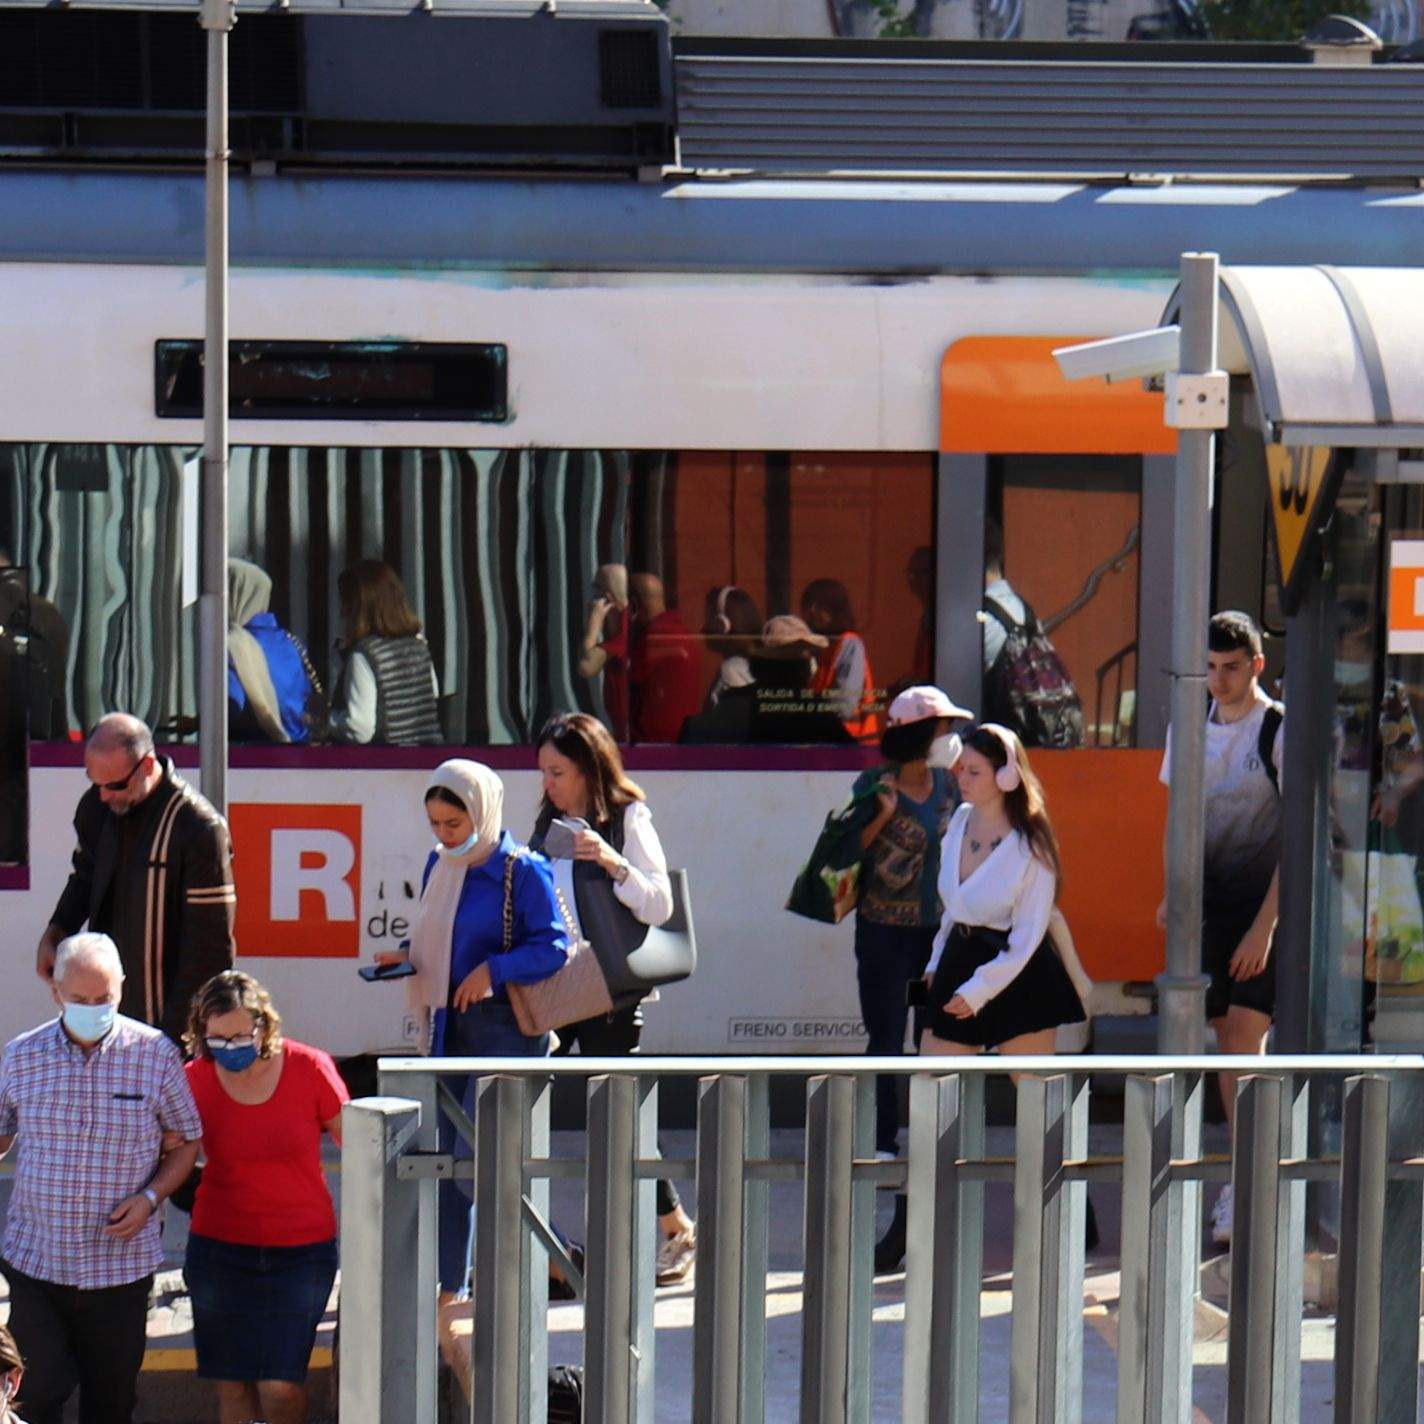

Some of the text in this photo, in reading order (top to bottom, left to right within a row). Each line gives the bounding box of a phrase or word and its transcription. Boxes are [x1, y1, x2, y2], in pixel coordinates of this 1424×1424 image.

[269, 828, 357, 922] R
[367, 909, 409, 939] de
[733, 1021, 867, 1037] FRENO SERVICIO
